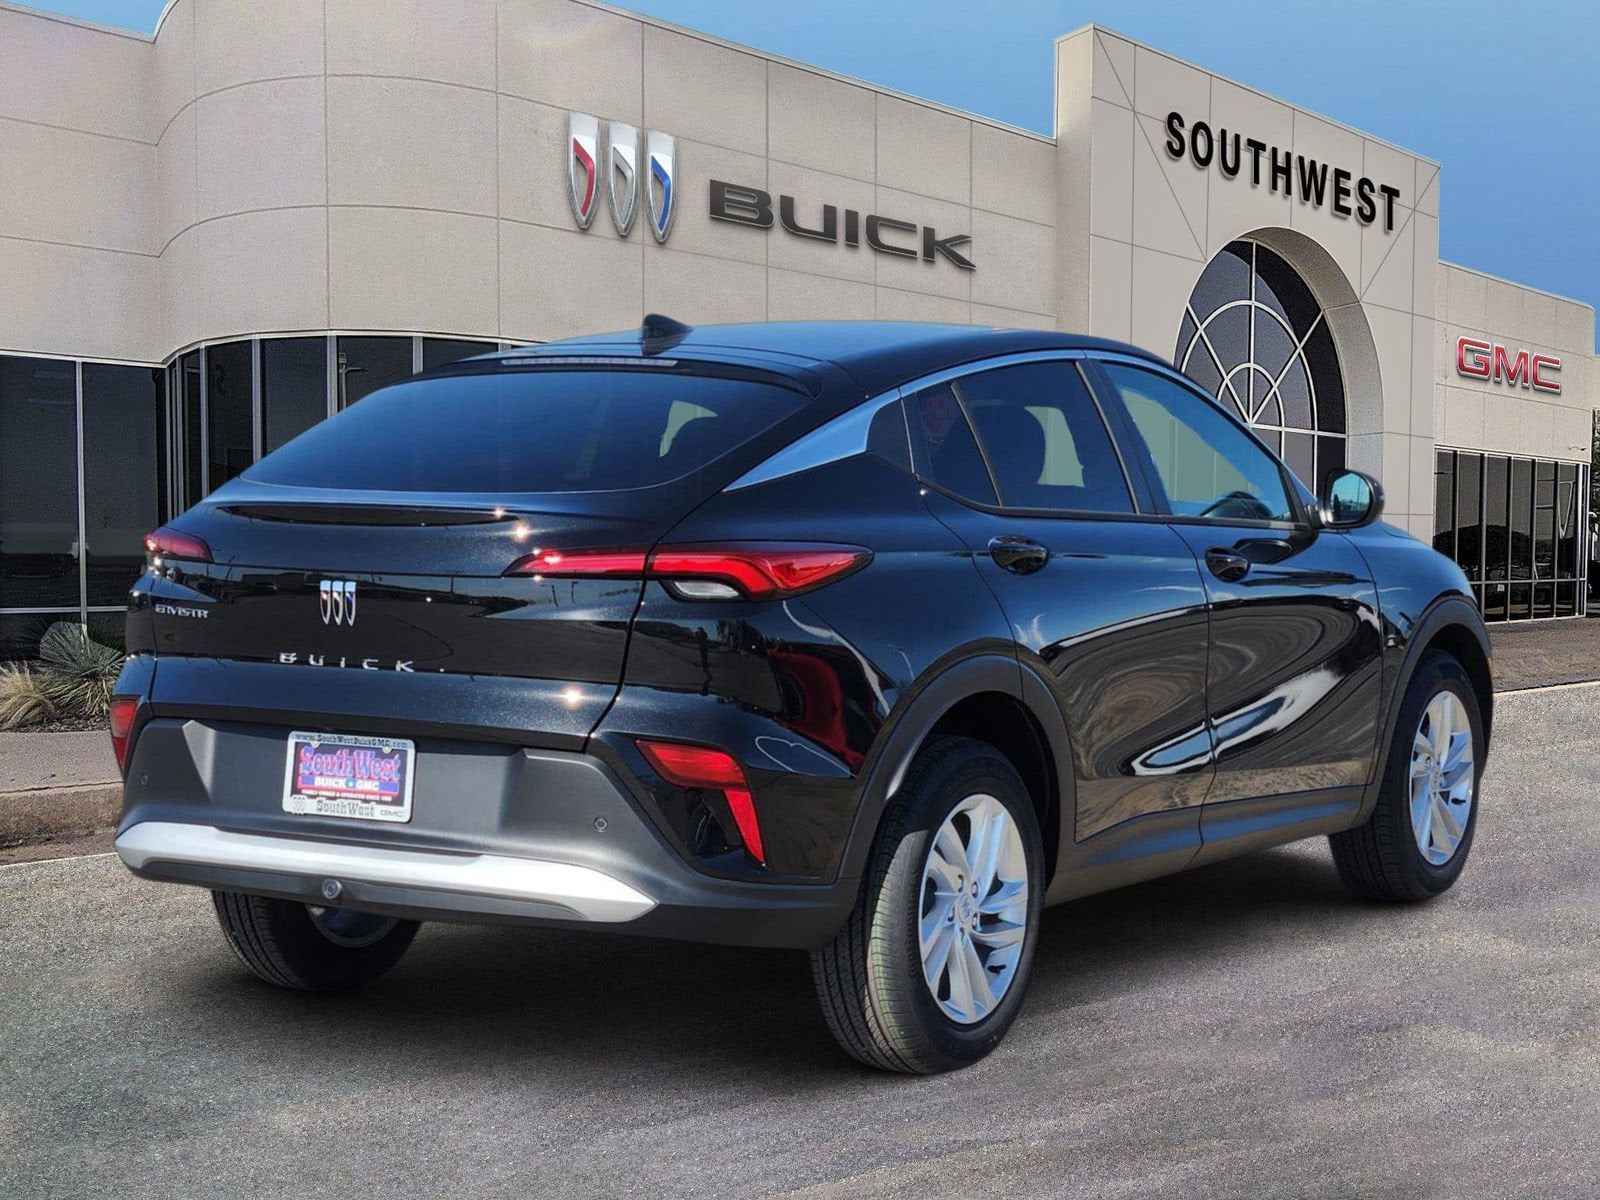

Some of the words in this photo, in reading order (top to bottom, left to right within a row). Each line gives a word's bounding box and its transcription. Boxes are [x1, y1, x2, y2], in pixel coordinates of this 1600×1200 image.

[1166, 111, 1400, 231] SOUTHWEST
[709, 179, 976, 270] BUICK
[1457, 336, 1561, 394] GMC
[279, 652, 415, 673] BUICK
[314, 776, 346, 790] BUICK
[356, 780, 380, 791] GMC
